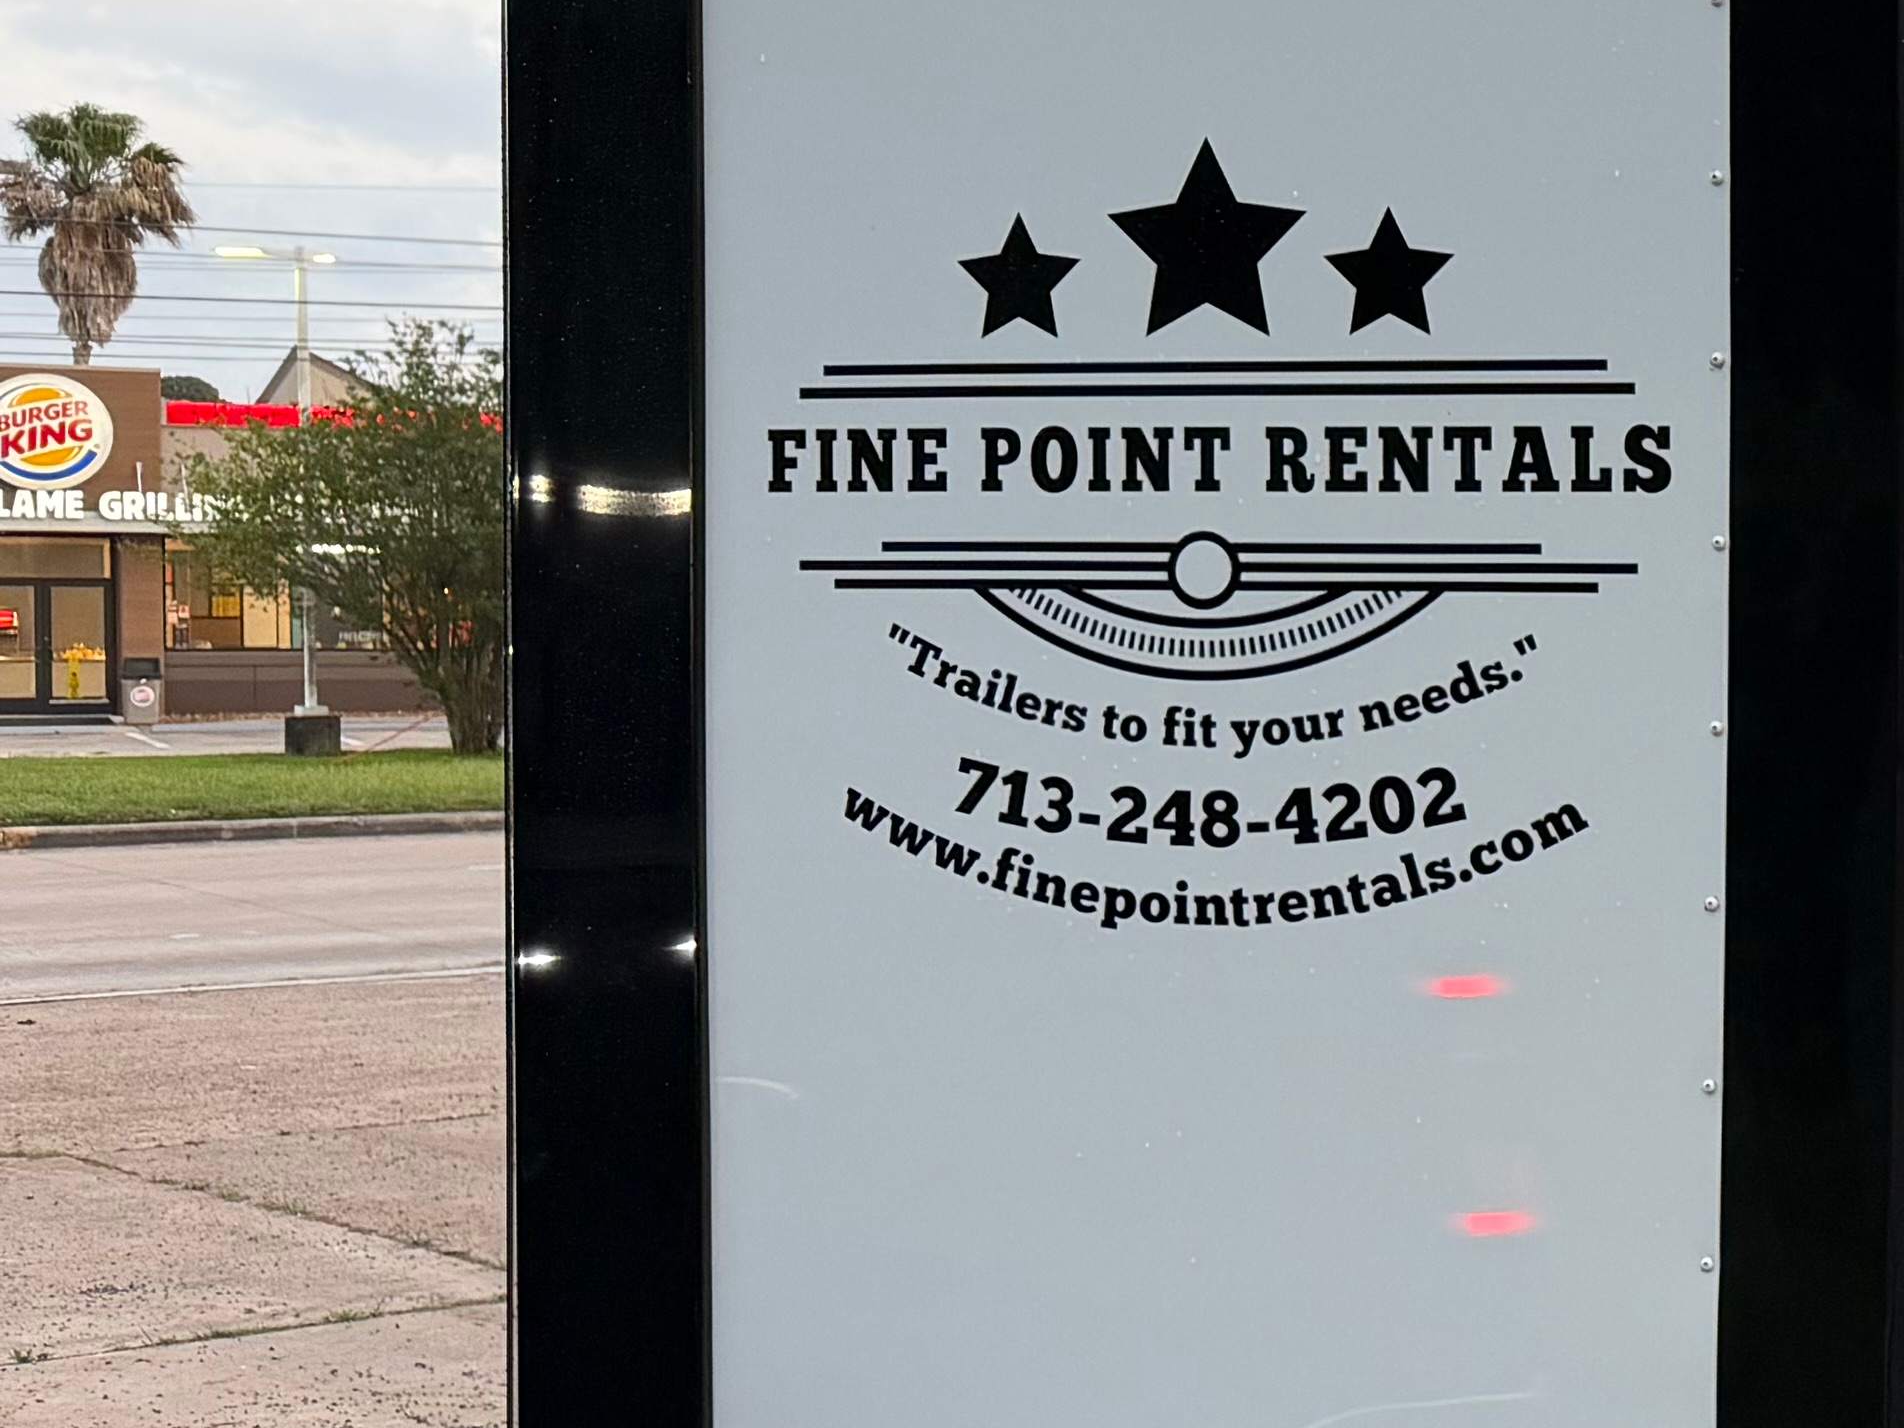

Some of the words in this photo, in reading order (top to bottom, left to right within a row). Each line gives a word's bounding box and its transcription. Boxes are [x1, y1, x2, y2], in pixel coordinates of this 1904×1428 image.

[0, 401, 88, 432] BURGER
[1, 418, 93, 459] KING
[766, 427, 949, 494] FINE
[980, 425, 1232, 494] POINT
[1265, 424, 1673, 494] RENTALS
[887, 622, 1089, 734] "Trailers
[1101, 705, 1149, 744] to
[1162, 705, 1218, 749] fit
[1229, 707, 1345, 760] your
[1357, 633, 1539, 732] needs."
[953, 755, 1468, 849] 713-248-4202
[843, 785, 1591, 930] www.finepointrentals.com
